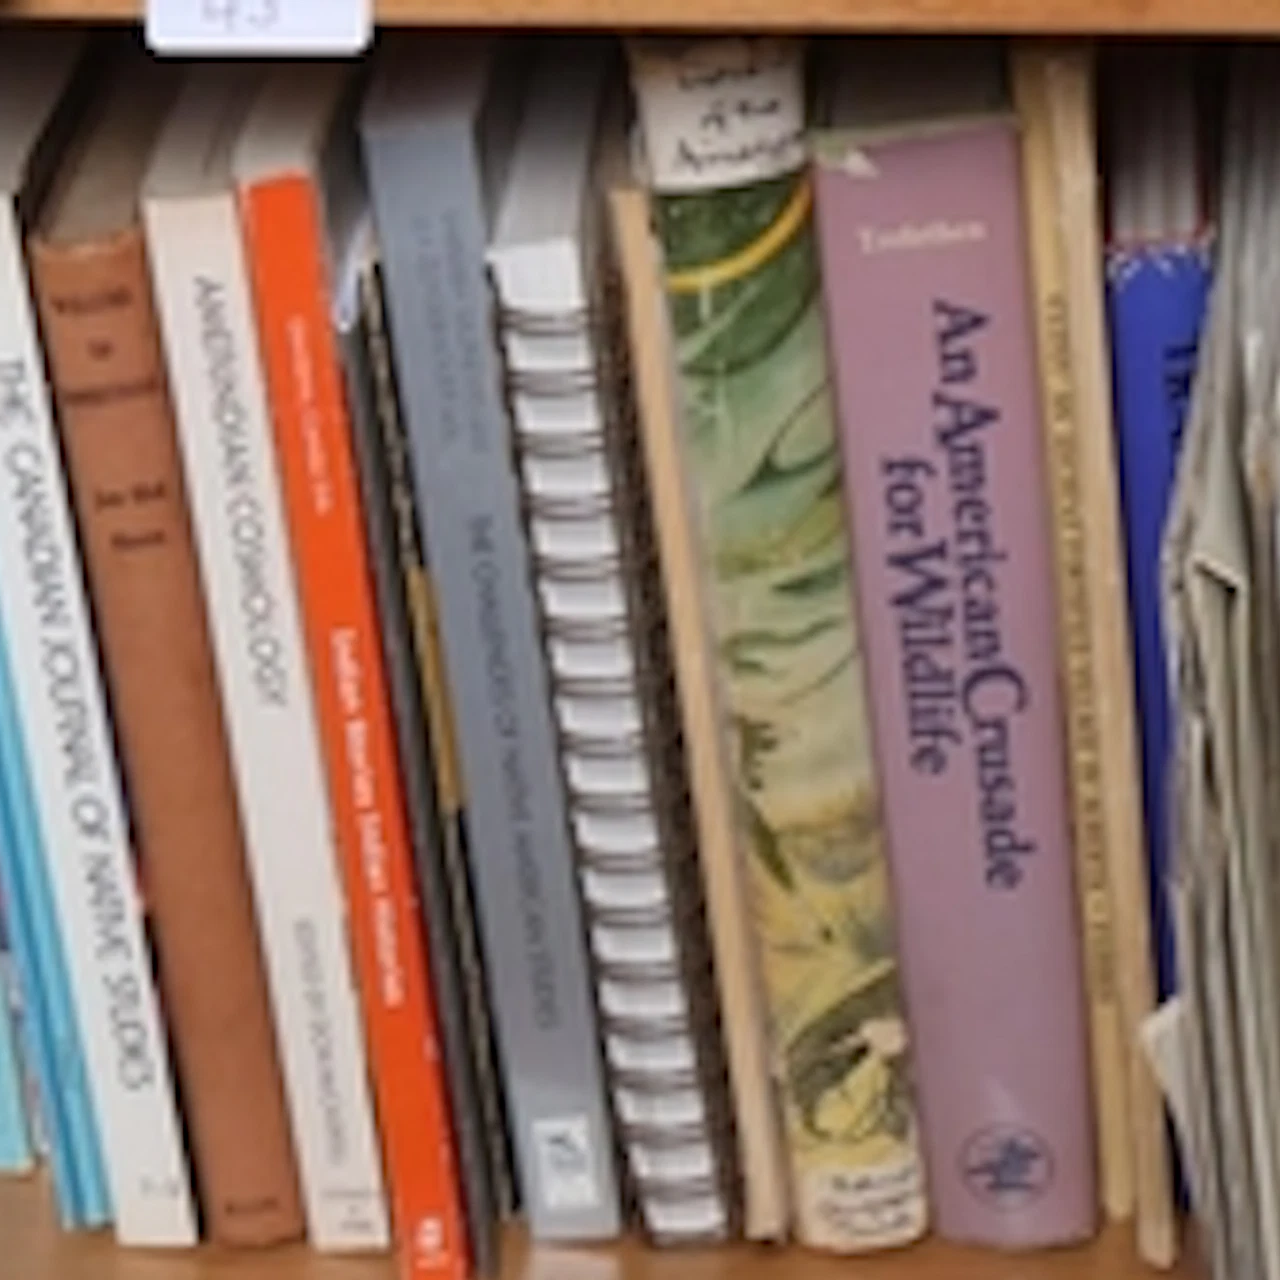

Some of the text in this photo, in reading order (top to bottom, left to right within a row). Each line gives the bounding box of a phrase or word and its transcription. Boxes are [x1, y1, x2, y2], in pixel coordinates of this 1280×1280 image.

[3, 444, 72, 636] CANADIAN
[228, 495, 287, 708] COSMOLOGY
[880, 454, 964, 777] for Wildlife
[931, 298, 1039, 891] An American Crusade
[41, 638, 110, 792] JOURNAL
[72, 795, 110, 844] OF
[85, 850, 133, 963] NATIVE
[103, 969, 152, 1092] STUDIES
